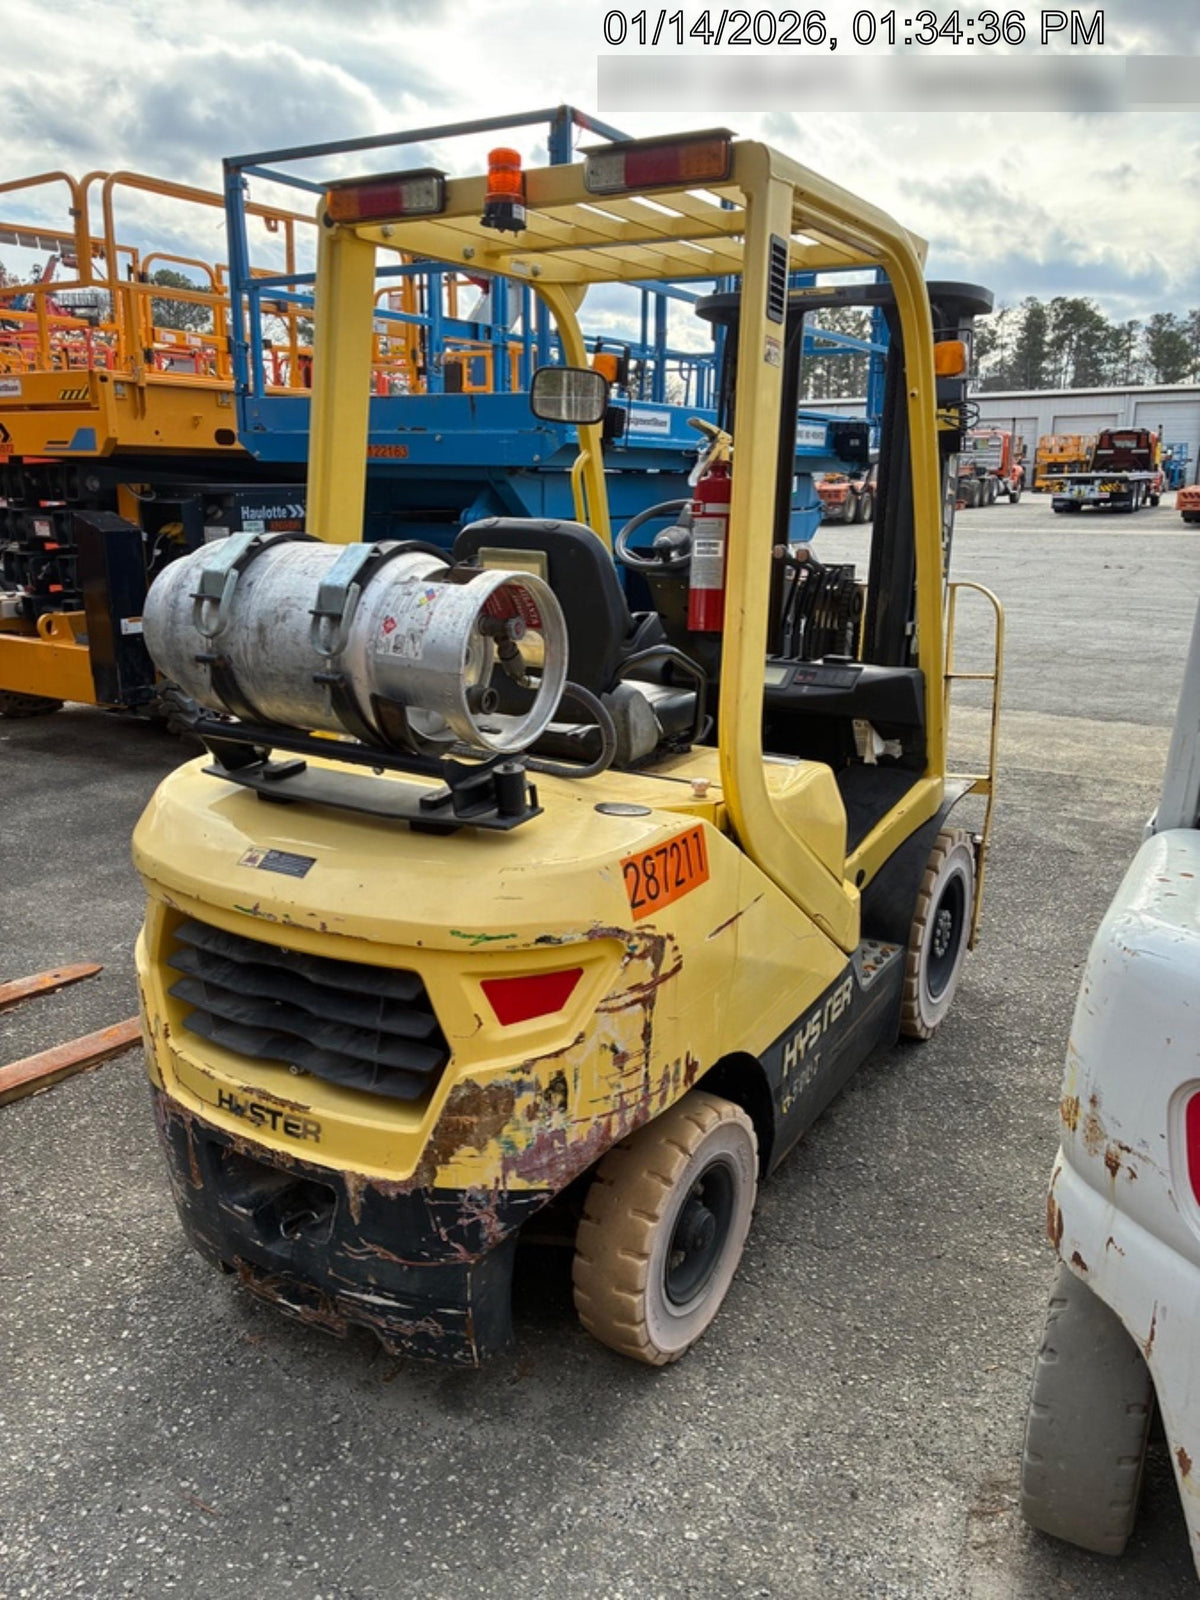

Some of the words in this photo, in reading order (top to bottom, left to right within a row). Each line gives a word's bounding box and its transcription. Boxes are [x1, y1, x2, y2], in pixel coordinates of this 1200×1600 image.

[241, 505, 287, 519] Haulotte
[623, 831, 704, 909] 287211
[783, 976, 853, 1078] HYSTER
